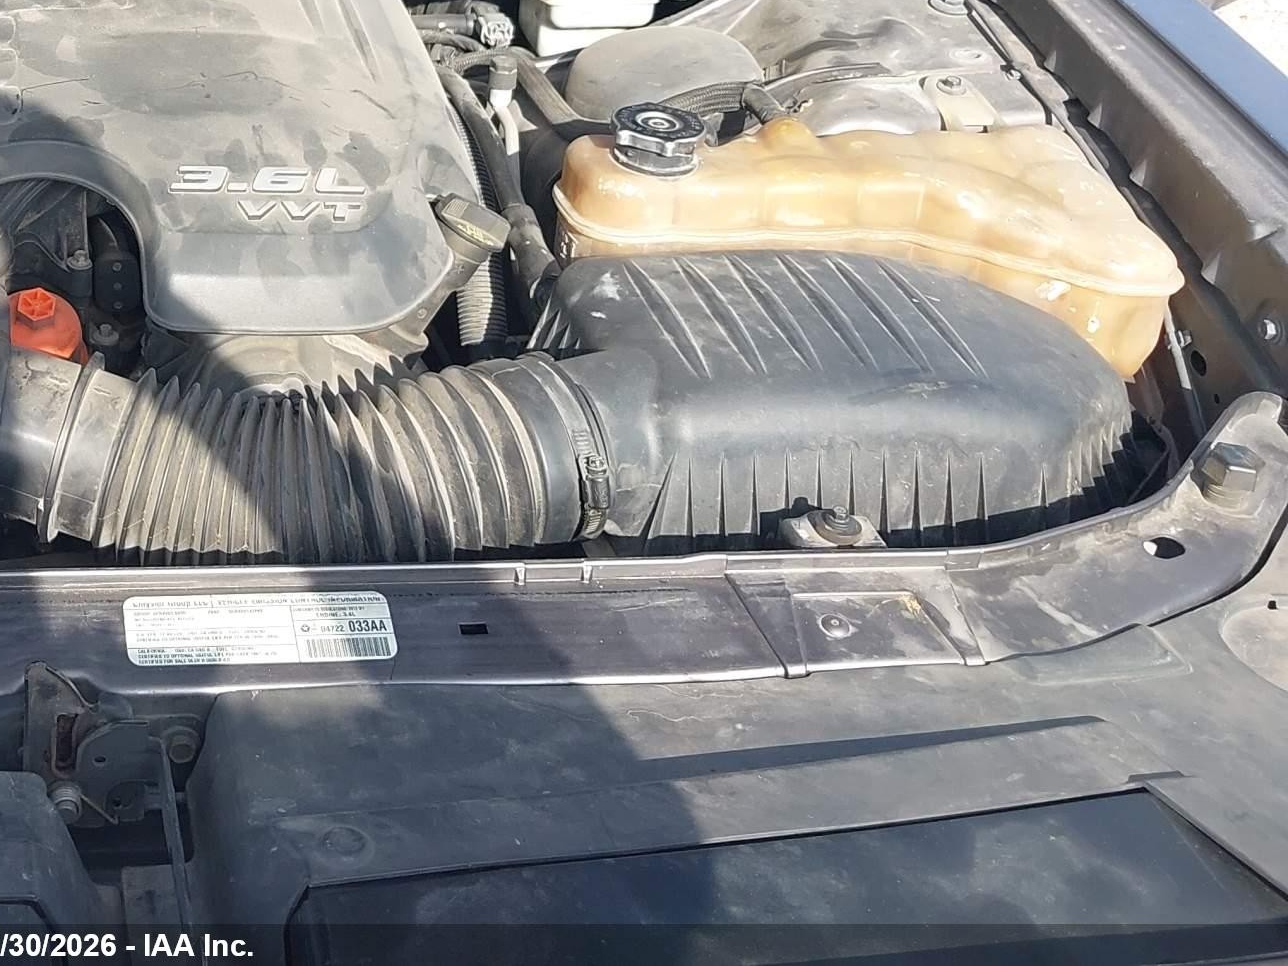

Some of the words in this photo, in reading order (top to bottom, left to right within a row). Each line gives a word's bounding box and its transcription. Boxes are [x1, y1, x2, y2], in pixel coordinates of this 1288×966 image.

[168, 165, 367, 195] 3.6L
[237, 200, 362, 222] VVT
[348, 619, 388, 633] 033AA
